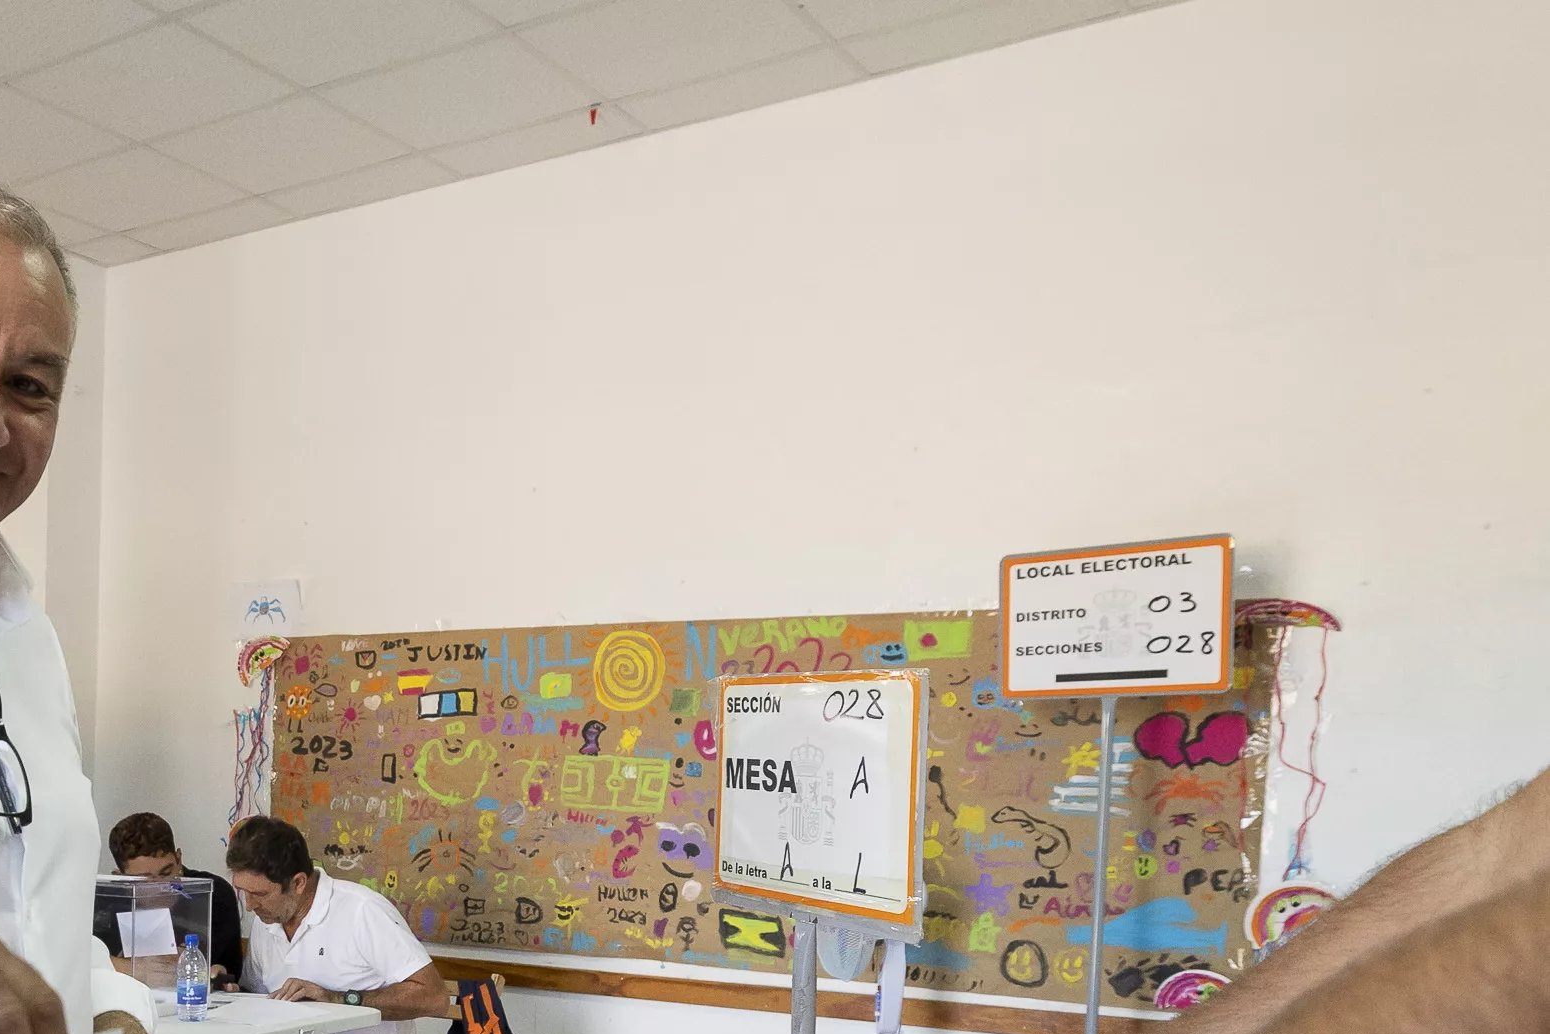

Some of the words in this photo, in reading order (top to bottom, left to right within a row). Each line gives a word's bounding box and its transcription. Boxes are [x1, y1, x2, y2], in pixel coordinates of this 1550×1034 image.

[1016, 564, 1074, 580] LOCAL
[1081, 552, 1192, 575] ELECTORAL
[1016, 608, 1086, 623] DISTRITO
[1148, 592, 1197, 613] 03
[407, 643, 488, 663] JUSTIN
[1015, 642, 1103, 657] SECCIONES
[1146, 631, 1216, 655] 028
[726, 692, 781, 713] SECCIÓN
[822, 689, 884, 722] 028
[291, 735, 354, 761] 2023
[726, 757, 797, 794] MESA
[849, 756, 869, 799] A
[722, 860, 733, 874] De
[735, 862, 743, 875] la
[746, 865, 768, 879] letra
[780, 842, 794, 881] A
[812, 880, 819, 888] a
[821, 877, 832, 891] la
[853, 852, 867, 895] L
[450, 919, 504, 934] 2023
[607, 907, 646, 925] 2023
